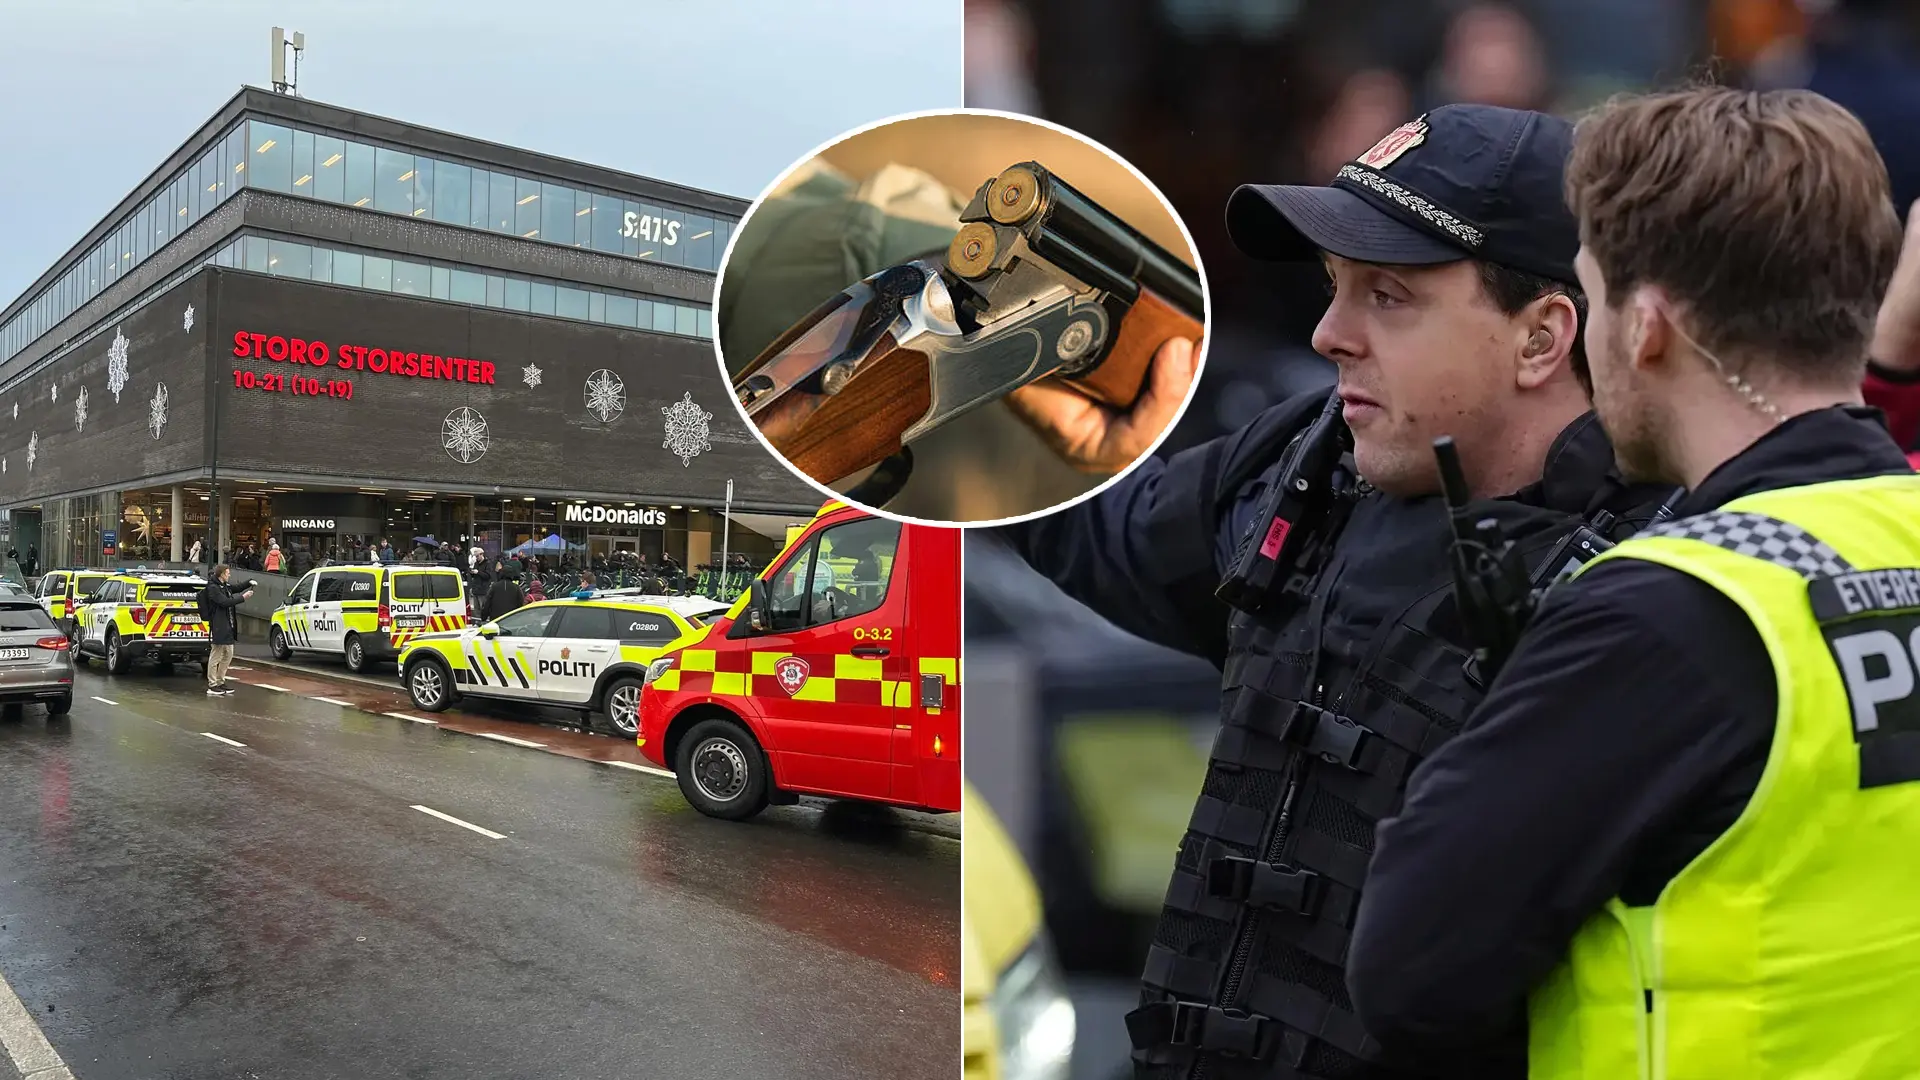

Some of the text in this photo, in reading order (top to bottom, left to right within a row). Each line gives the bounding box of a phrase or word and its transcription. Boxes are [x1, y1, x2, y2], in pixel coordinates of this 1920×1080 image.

[618, 211, 681, 246] SATS
[233, 330, 496, 385] STORO STORSENTER
[233, 370, 353, 400] 10-21 (10-19)
[282, 519, 335, 529] INNGANG
[565, 504, 666, 526] McDonald's
[1834, 569, 1920, 614] ETTERF
[390, 604, 420, 613] POLITI
[314, 619, 337, 632] POLITI
[635, 623, 659, 631] 02800
[1, 649, 27, 657] 73393
[538, 659, 596, 678] POLITI
